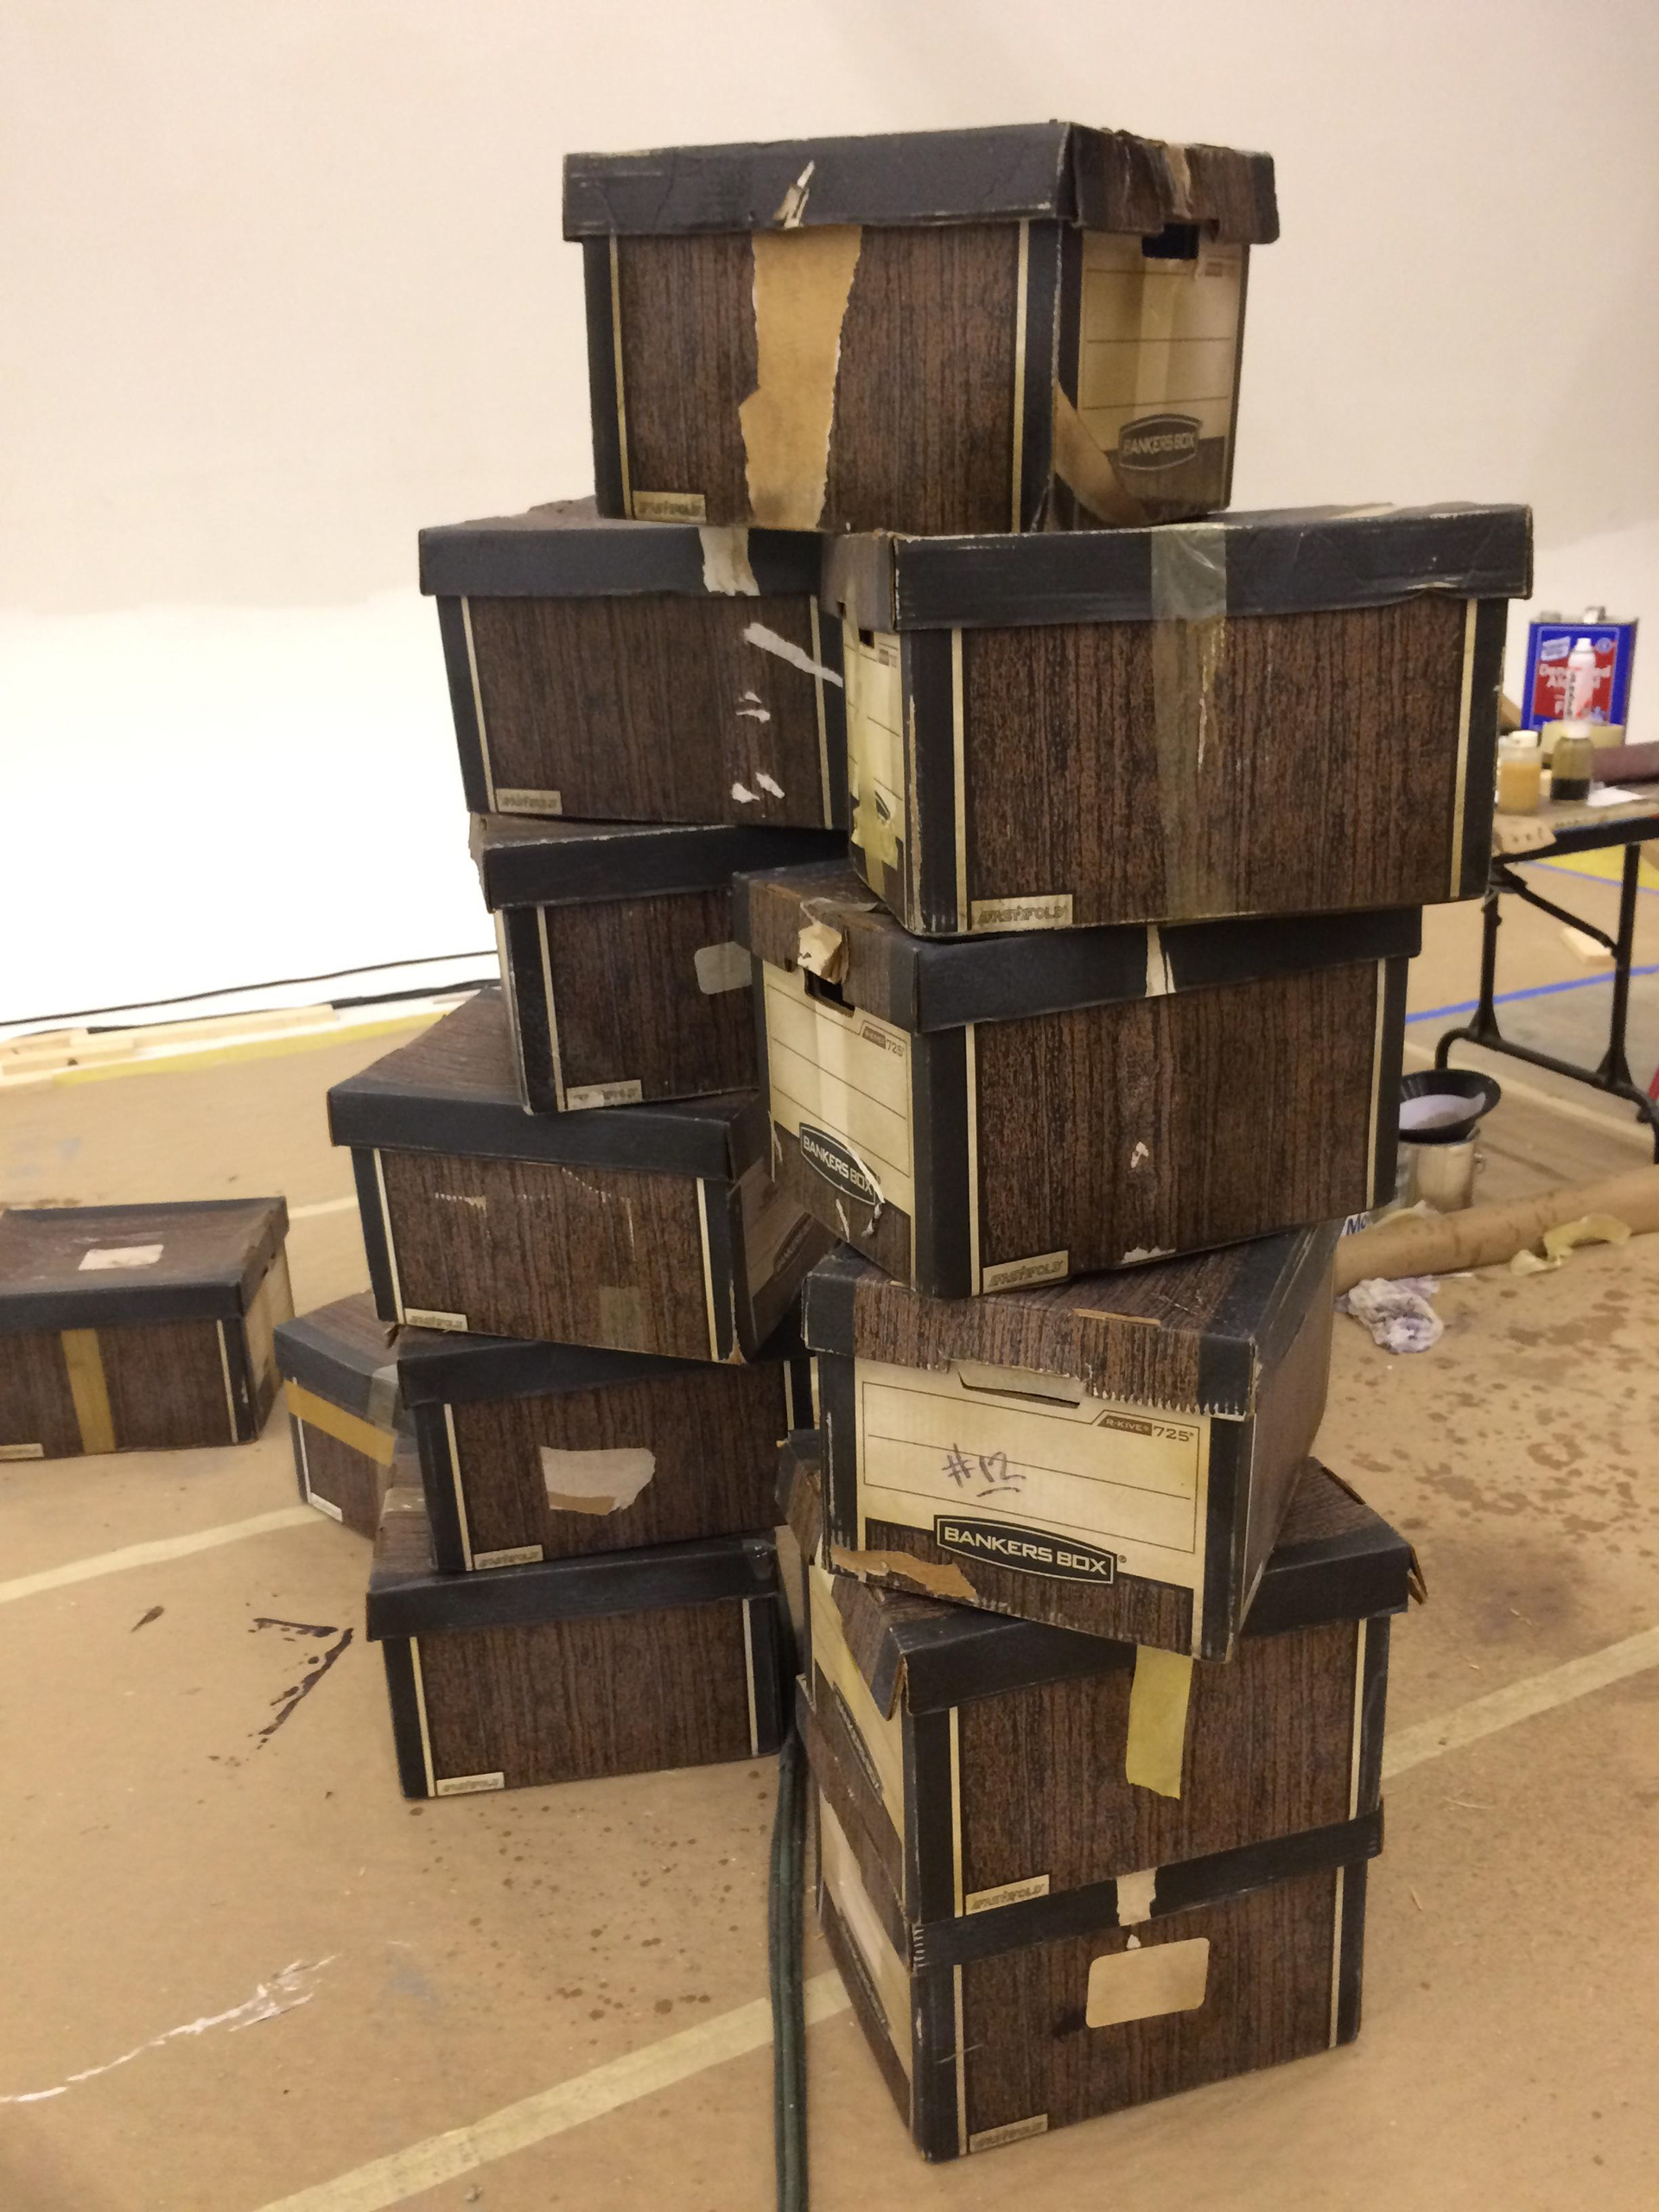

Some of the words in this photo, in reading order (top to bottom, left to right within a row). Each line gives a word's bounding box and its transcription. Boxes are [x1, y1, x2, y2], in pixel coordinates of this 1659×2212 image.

[1125, 435, 1173, 455] BANKERS
[1174, 433, 1194, 449] BOX
[887, 1039, 904, 1058] 725
[803, 1135, 849, 1179] BANKERS
[849, 1167, 873, 1196] BOX
[1154, 1425, 1190, 1442] 725
[941, 1442, 1027, 1488] #12
[944, 1526, 1053, 1563] BANKERS
[1056, 1550, 1108, 1575] BOX
